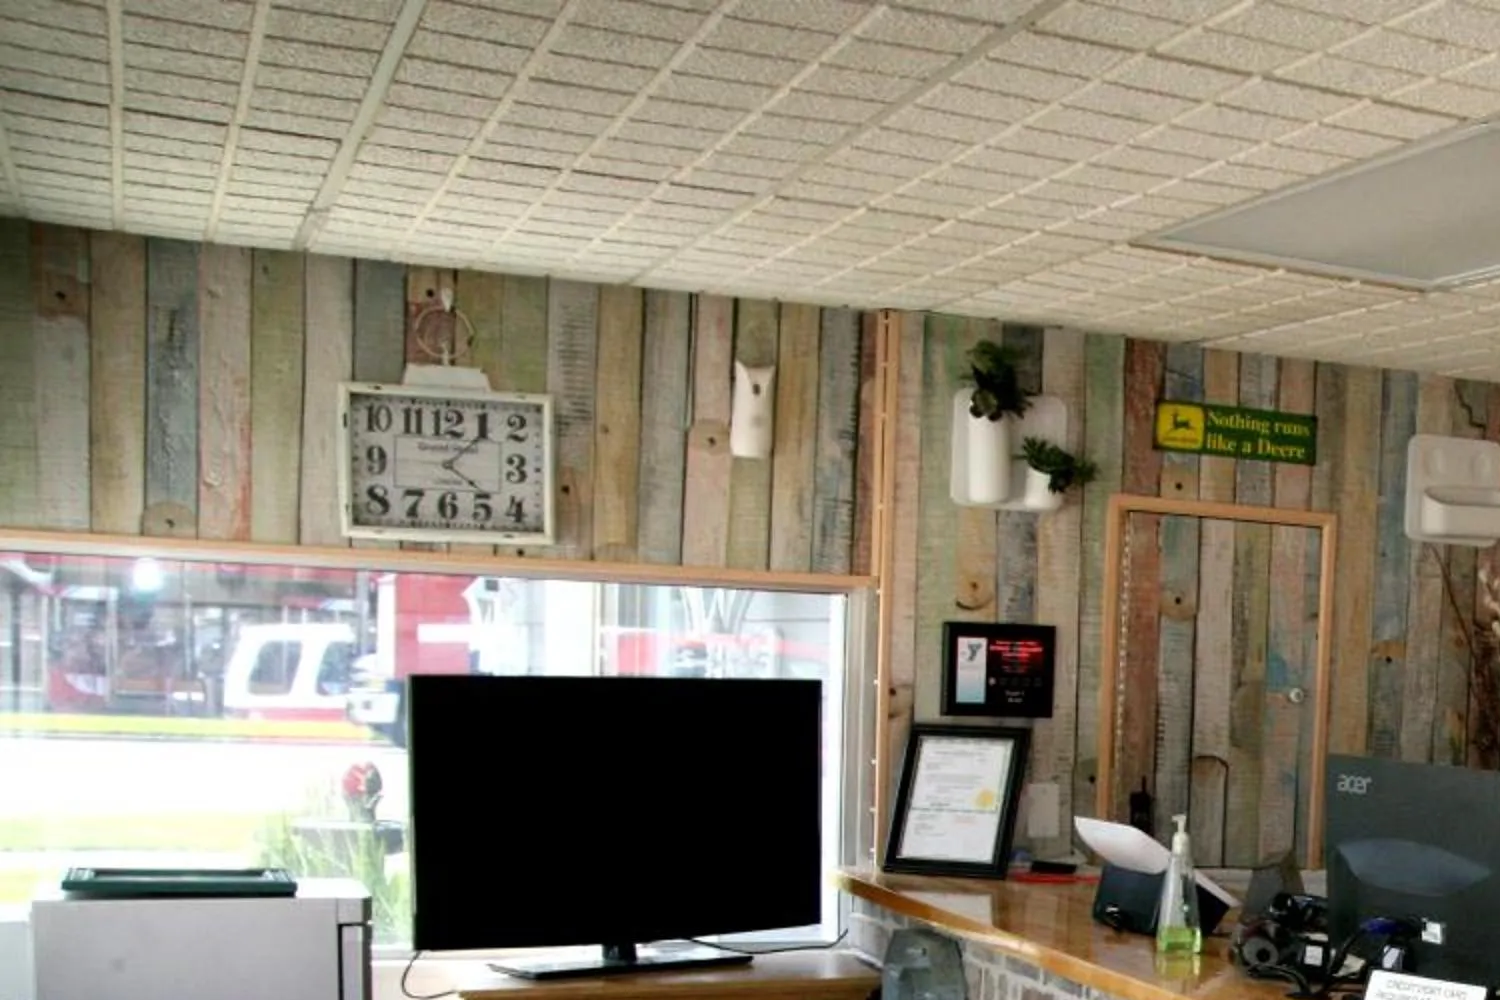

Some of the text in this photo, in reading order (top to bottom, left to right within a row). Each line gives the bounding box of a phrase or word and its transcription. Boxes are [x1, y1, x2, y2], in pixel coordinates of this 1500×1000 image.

[365, 404, 528, 442] 10 11 12 1 2
[1207, 409, 1311, 437] Nothing runs
[1206, 432, 1238, 452] like
[1257, 436, 1306, 459] Deere
[366, 444, 528, 484] 9 3
[366, 483, 528, 523] 8 7 6 5 4
[1336, 773, 1373, 795] acer
